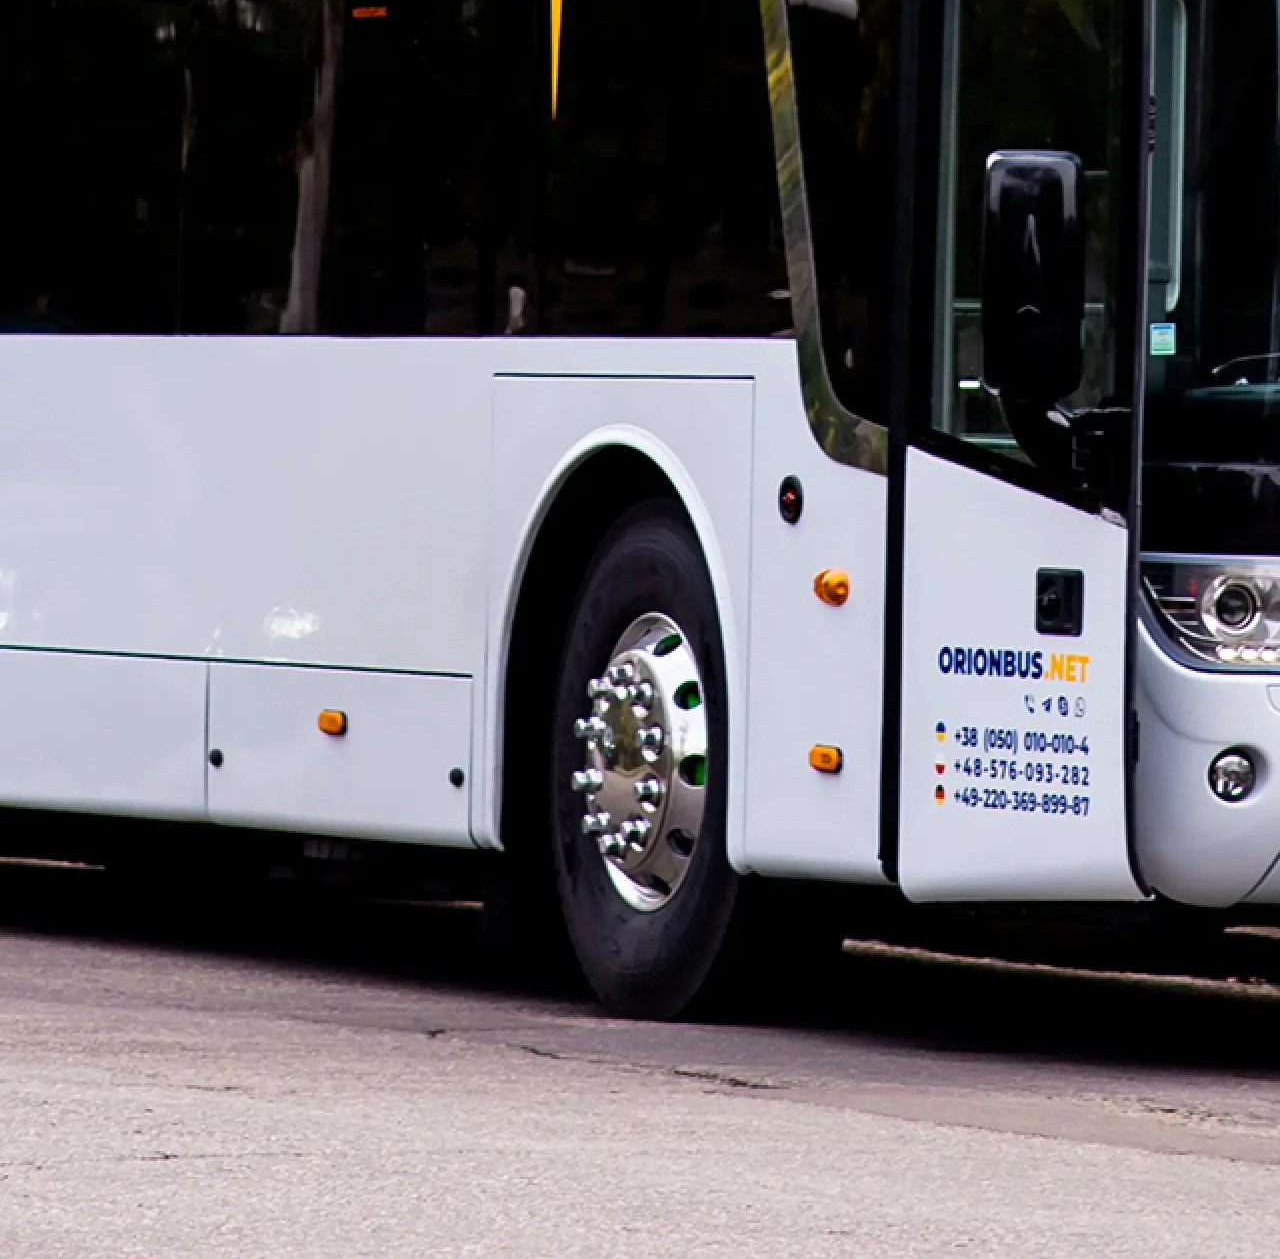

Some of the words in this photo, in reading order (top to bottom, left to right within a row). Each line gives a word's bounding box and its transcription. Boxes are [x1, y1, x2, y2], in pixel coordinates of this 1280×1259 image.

[937, 645, 1091, 683] ORIONBUS.NET
[954, 726, 978, 747] +38
[983, 727, 1019, 755] (050)
[1024, 730, 1090, 756] 010-010-4
[954, 757, 1090, 786] +48-576-093-282
